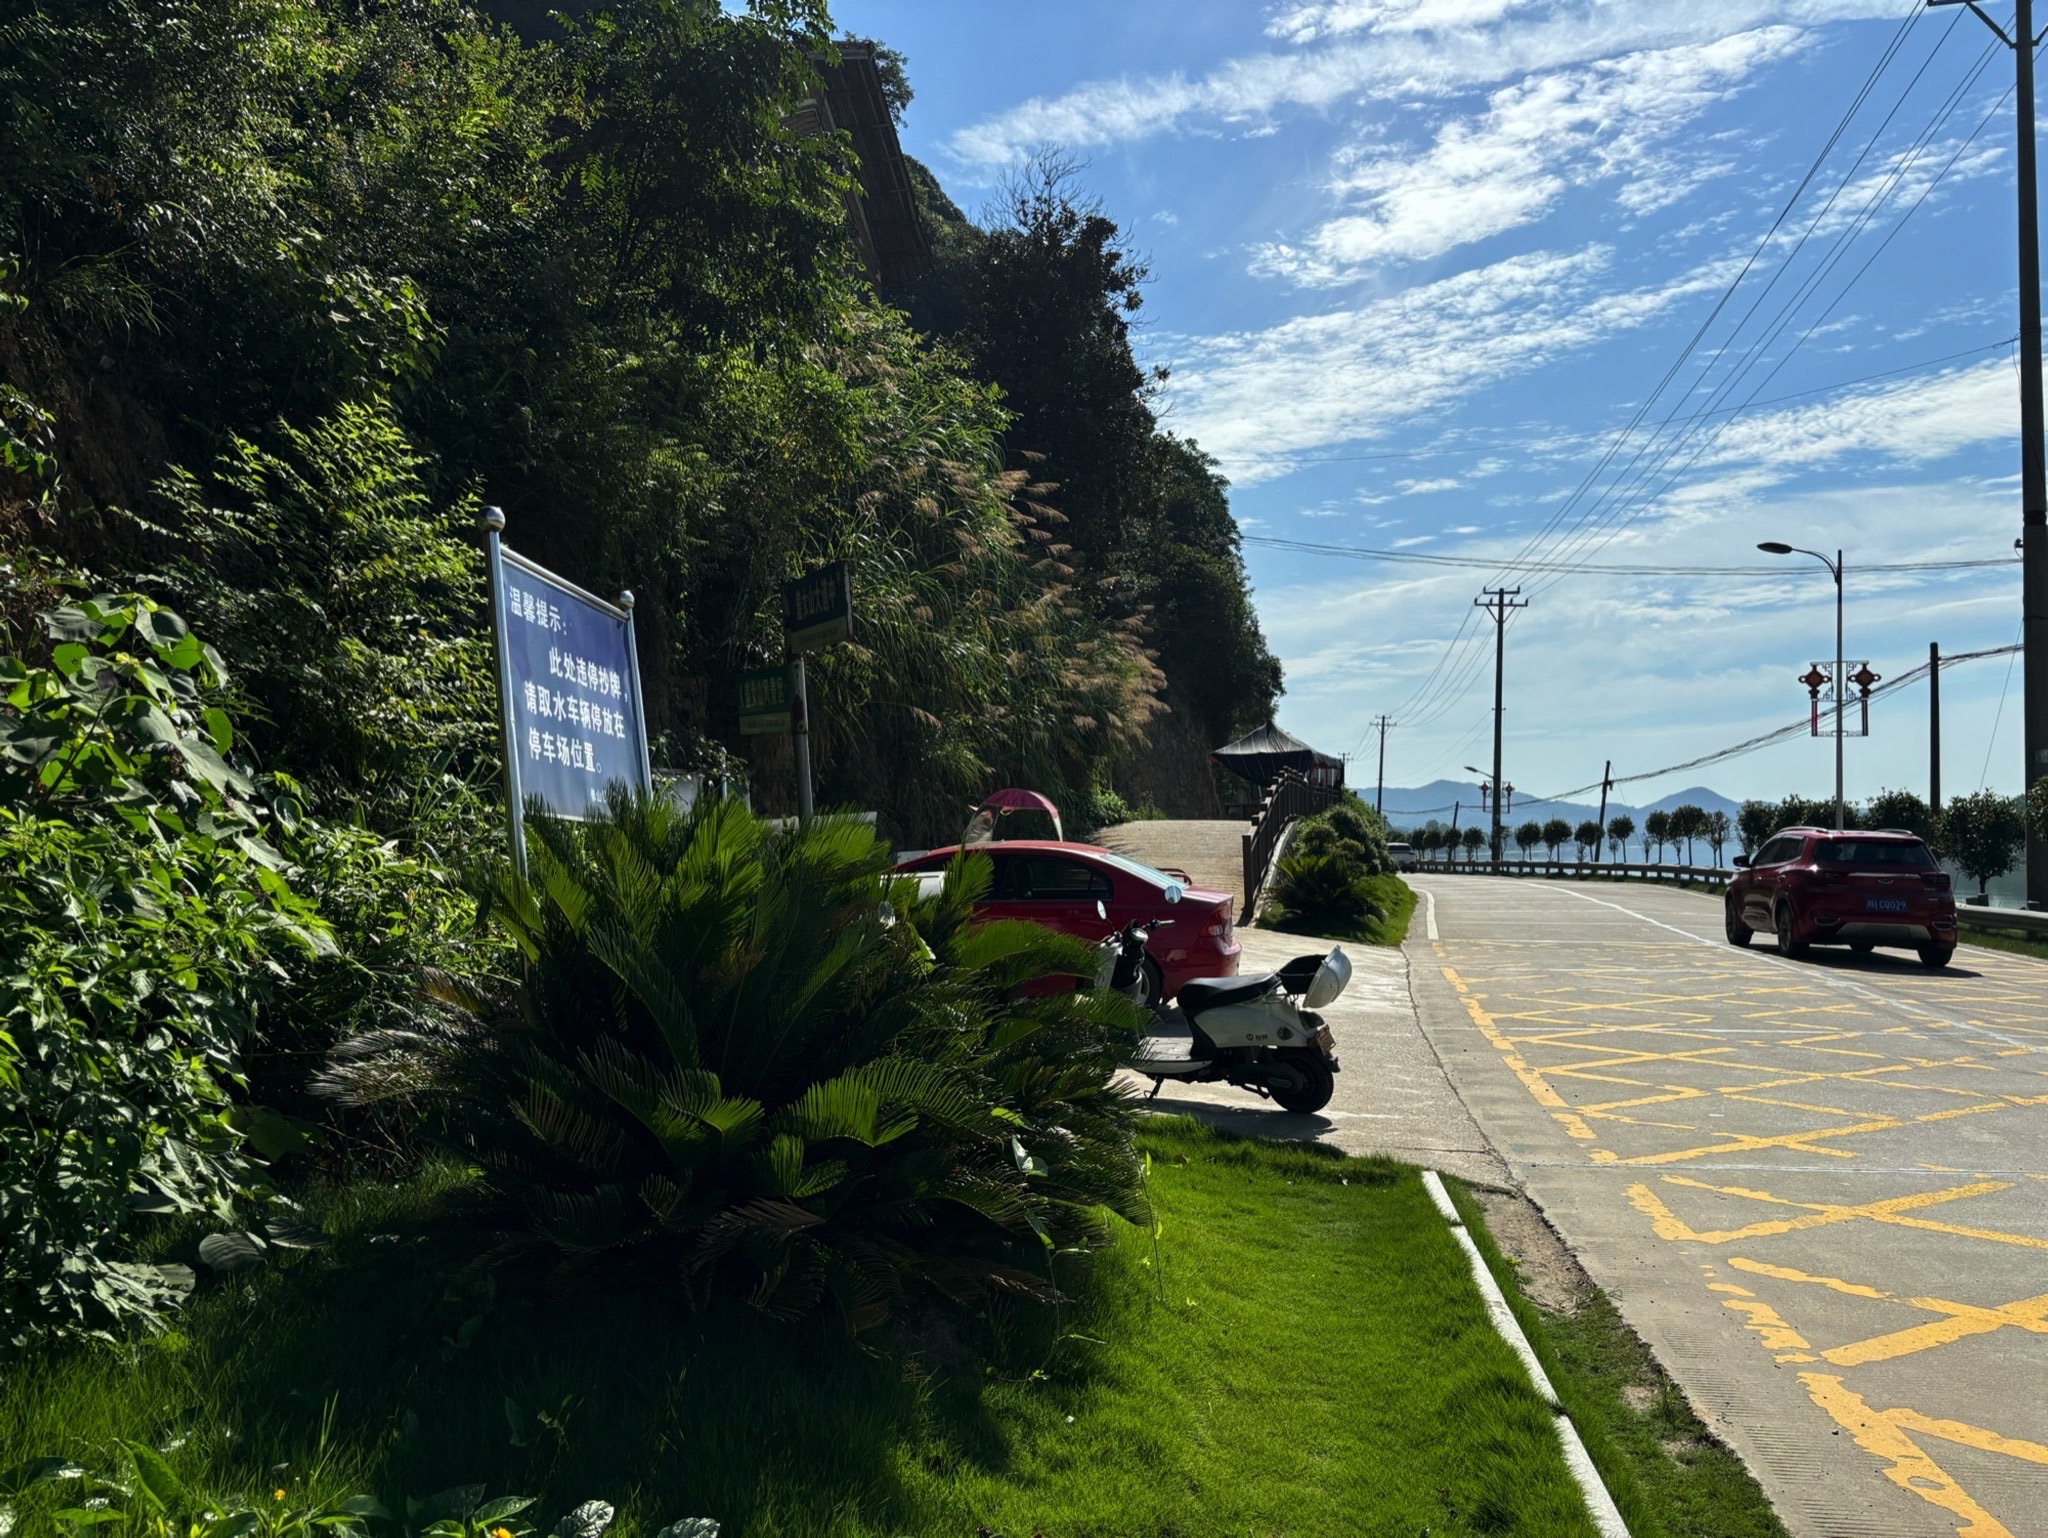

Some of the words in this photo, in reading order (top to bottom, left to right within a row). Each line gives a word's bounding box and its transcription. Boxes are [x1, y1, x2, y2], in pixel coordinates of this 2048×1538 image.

[509, 585, 567, 636] 温馨提示：
[549, 647, 628, 702] 此处违停抄牌，
[525, 680, 626, 738] 请取水车辆停放在
[529, 726, 602, 774] 停车场位置。
